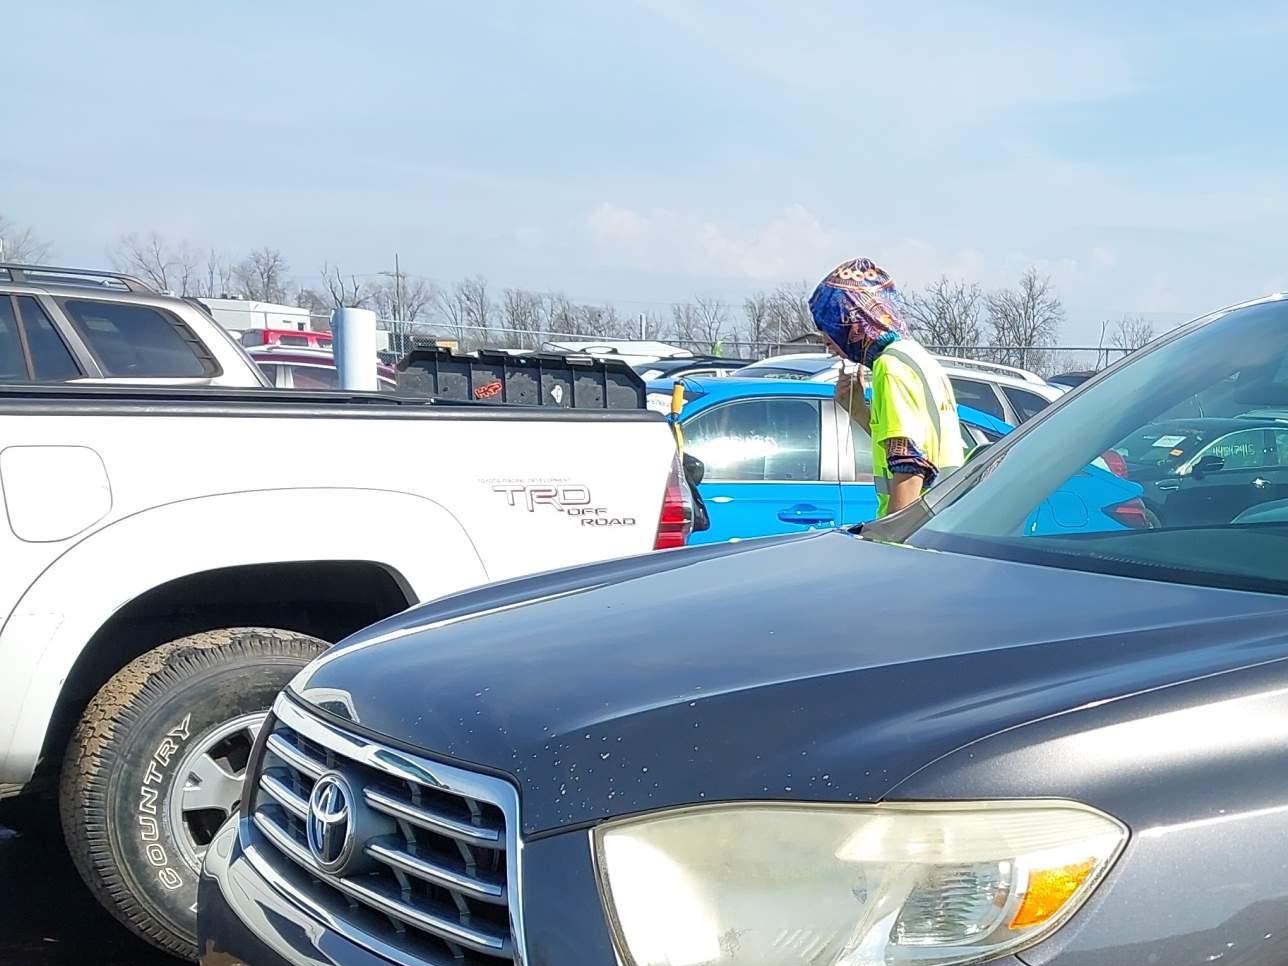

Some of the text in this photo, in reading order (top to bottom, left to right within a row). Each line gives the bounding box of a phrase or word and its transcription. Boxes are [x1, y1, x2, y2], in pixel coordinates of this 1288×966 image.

[491, 484, 591, 512] TRD
[567, 508, 608, 516] OFF
[581, 518, 636, 526] ROAD
[139, 712, 192, 890] COUNTRY
